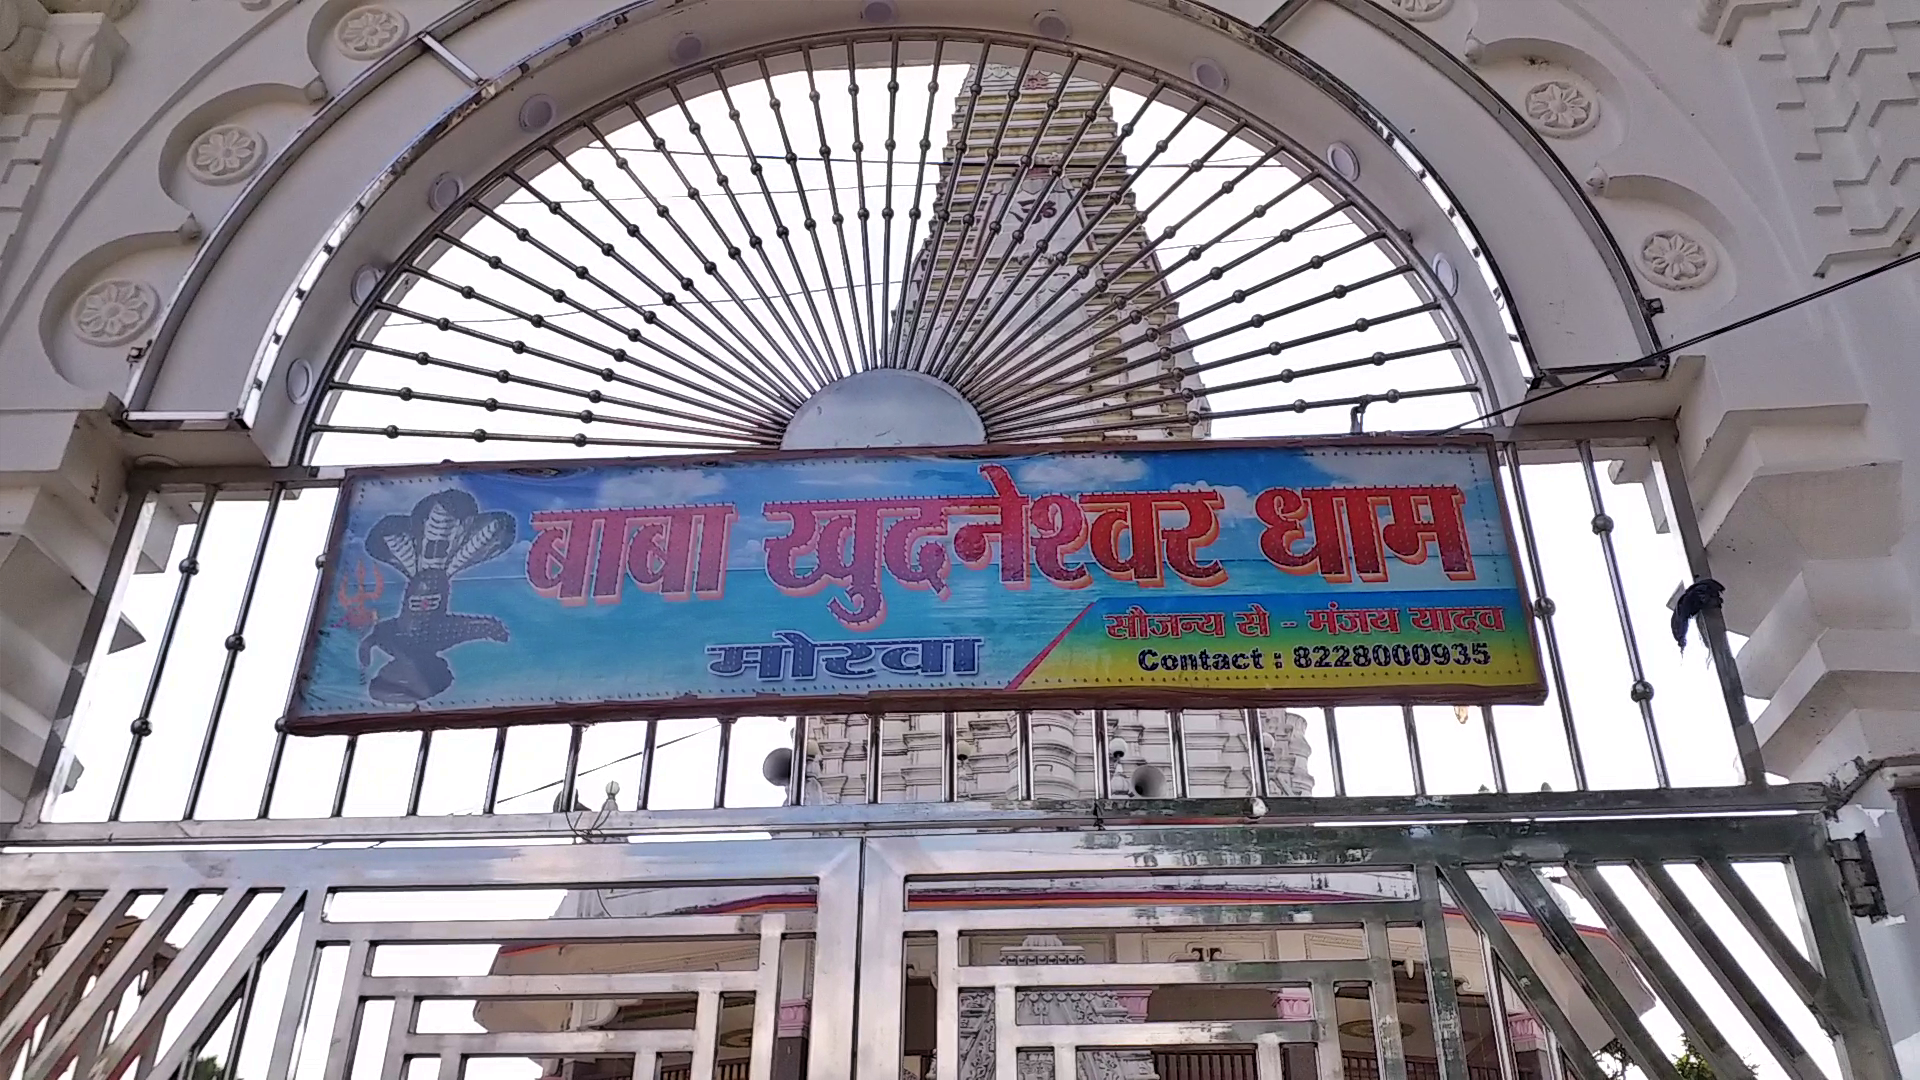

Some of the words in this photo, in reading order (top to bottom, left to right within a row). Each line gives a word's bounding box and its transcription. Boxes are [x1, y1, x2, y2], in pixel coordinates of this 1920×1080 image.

[526, 502, 738, 606] बाबा
[763, 463, 1230, 632] खुदनेश्वर
[1254, 484, 1477, 583] धाम
[1104, 604, 1225, 640] सौजन्य
[1233, 603, 1271, 638] से
[1304, 601, 1400, 635] मंजय
[1407, 606, 1505, 634] यादव
[705, 629, 985, 682] मोरवा
[1138, 648, 1265, 671] Contact
[1293, 642, 1491, 669] 8228000935
